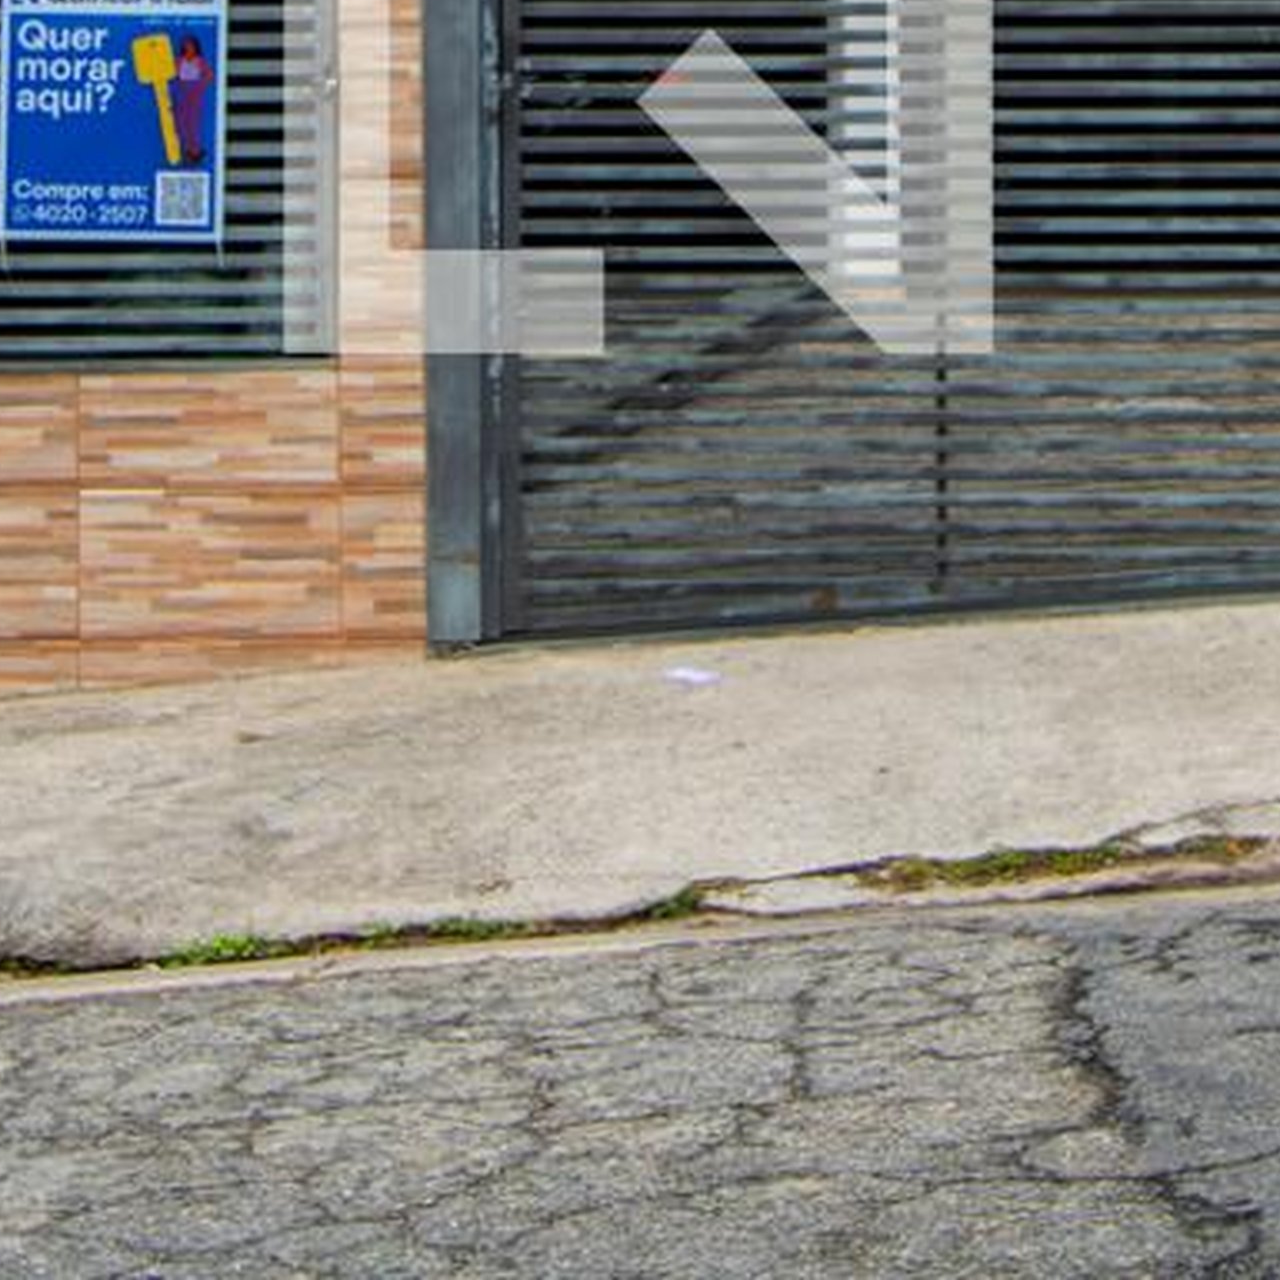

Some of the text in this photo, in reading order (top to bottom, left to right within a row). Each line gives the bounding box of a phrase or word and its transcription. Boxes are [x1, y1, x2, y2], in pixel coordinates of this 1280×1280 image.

[17, 19, 109, 52] Quer
[17, 56, 125, 82] morar
[15, 82, 116, 119] aqui?
[12, 178, 105, 205] Compre
